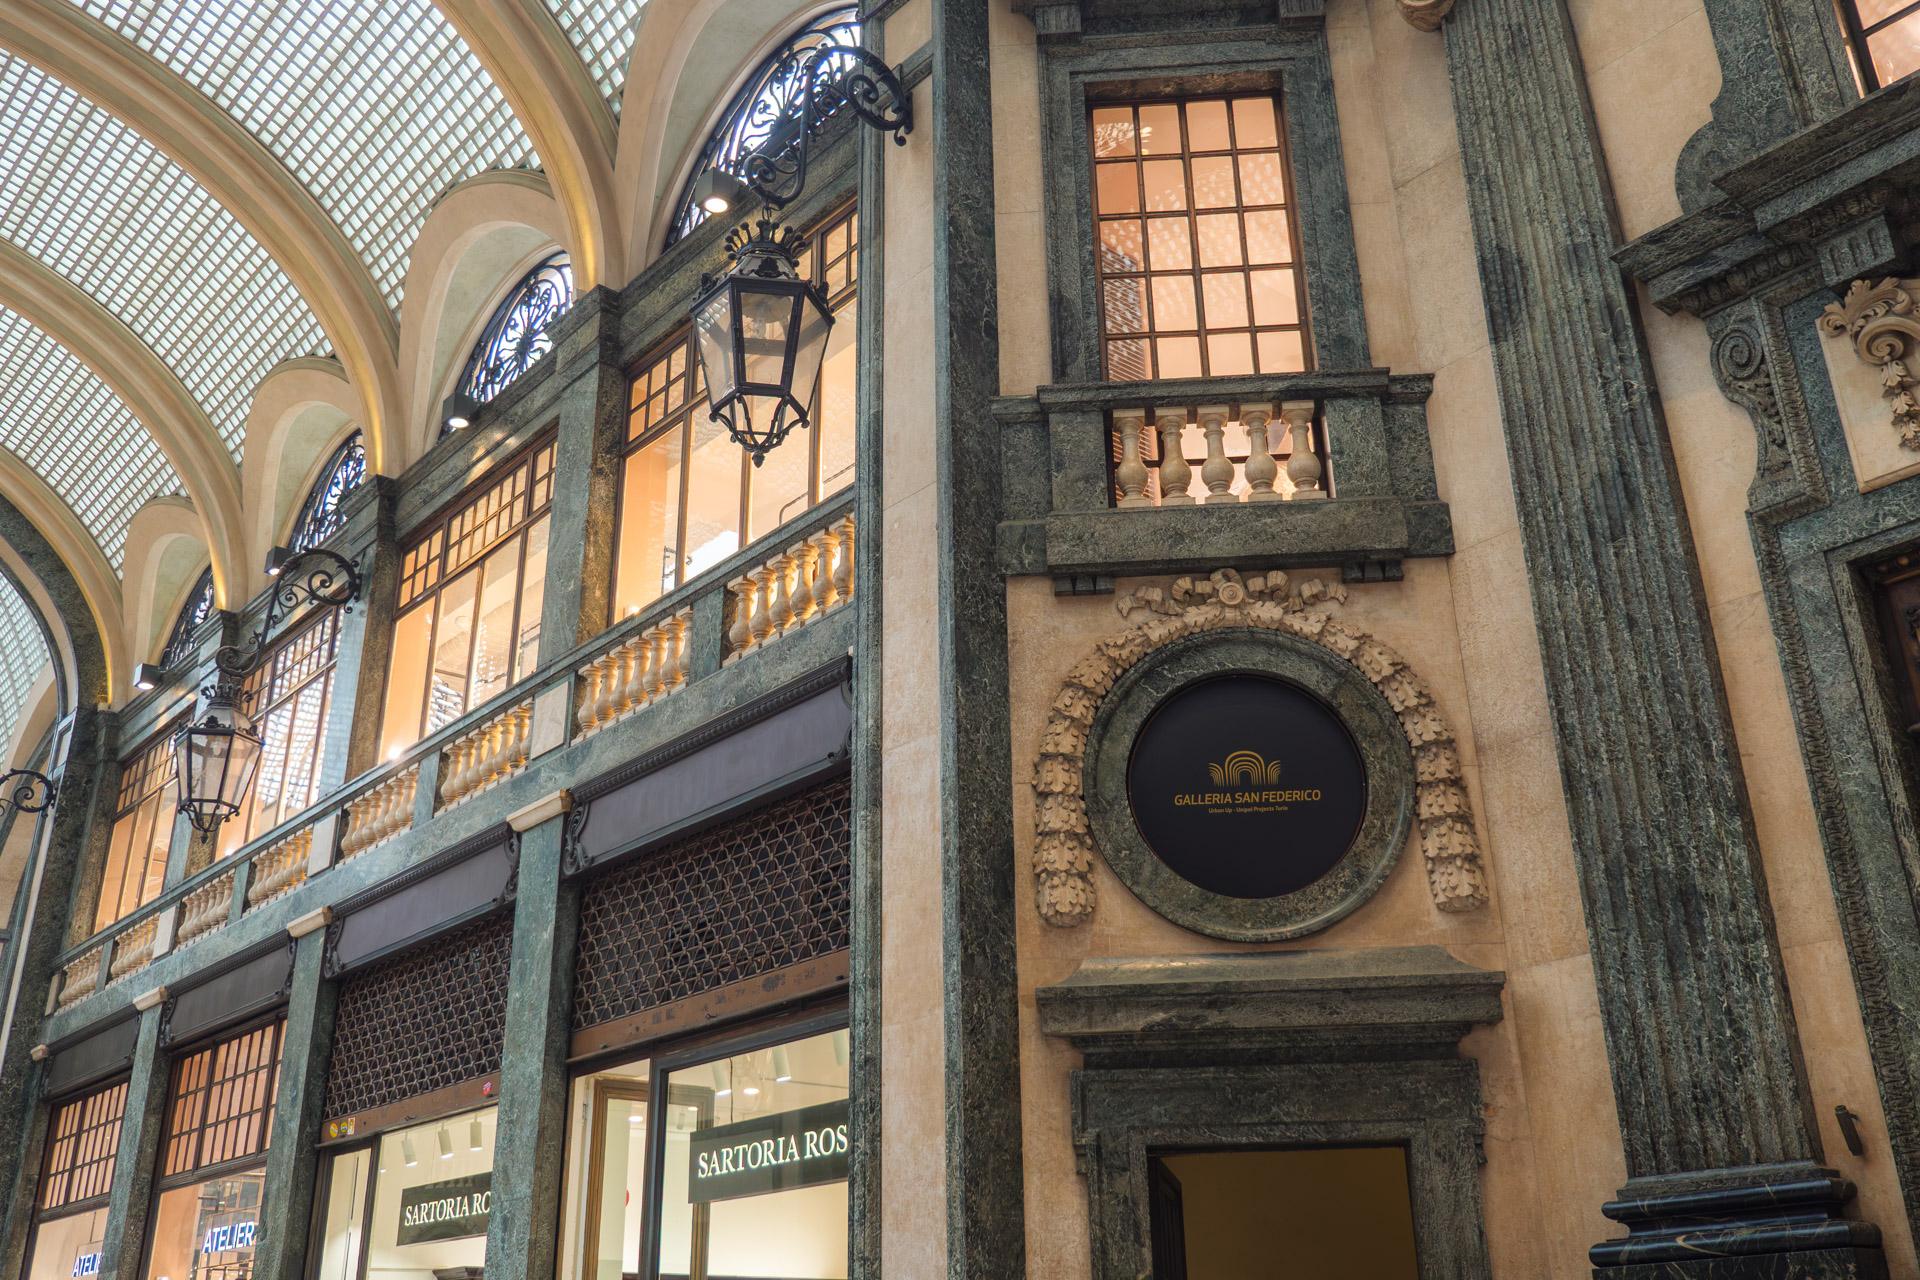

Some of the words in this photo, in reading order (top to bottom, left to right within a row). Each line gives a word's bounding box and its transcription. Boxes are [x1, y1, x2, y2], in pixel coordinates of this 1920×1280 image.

[1174, 793, 1232, 806] GALLERIA
[1234, 791, 1260, 804] SAN
[1262, 789, 1321, 803] FEDERICO
[1253, 805, 1275, 813] Projects
[698, 1134, 800, 1178] SARTORIA
[804, 1124, 848, 1159] ROS
[404, 1195, 470, 1226] SARTORIA
[202, 1221, 255, 1254] ATELIER
